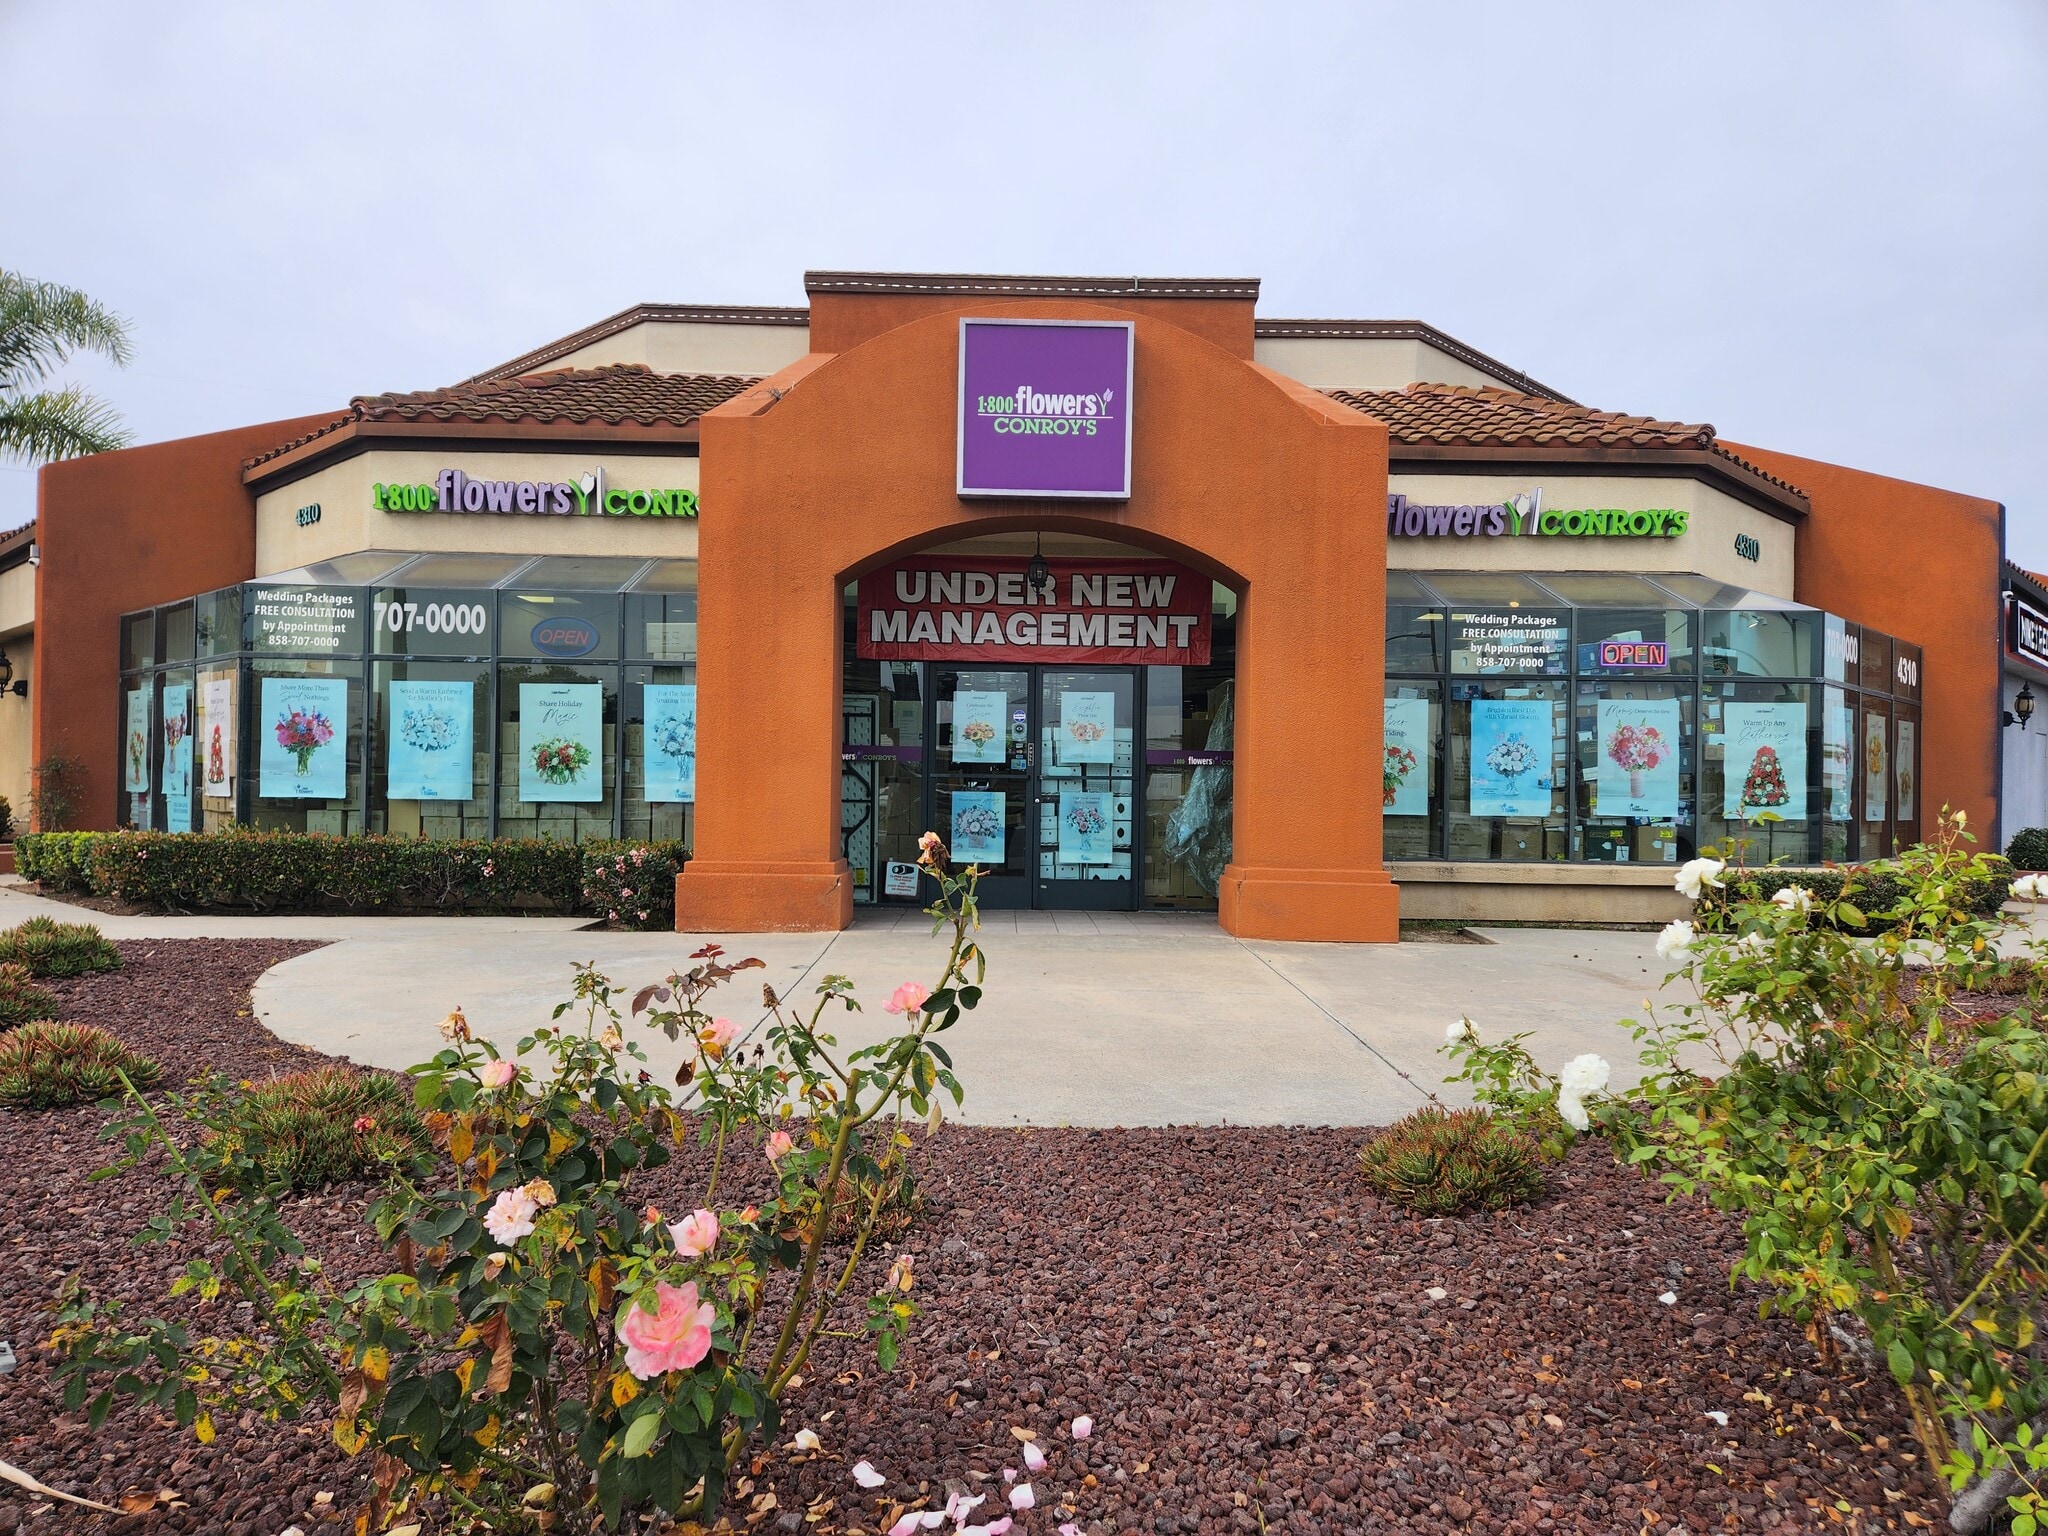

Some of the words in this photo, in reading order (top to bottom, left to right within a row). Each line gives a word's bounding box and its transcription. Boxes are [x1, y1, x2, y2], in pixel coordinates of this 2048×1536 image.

[994, 417, 1097, 436] CONROY'S
[603, 488, 699, 517] CONR
[295, 502, 321, 527] 4310
[1540, 508, 1690, 538] CONROY'S
[1735, 533, 1760, 563] 4310
[257, 590, 303, 604] Wedding
[305, 592, 353, 606] Packages
[895, 570, 1058, 606] UNDER
[1071, 574, 1178, 608] NEW
[254, 605, 279, 616] FREE
[281, 606, 355, 619] CONSULTATION
[373, 601, 486, 635] 707-0000
[1465, 614, 1509, 627] Wedding
[1511, 615, 1557, 628] Packages
[262, 620, 276, 633] by
[277, 620, 346, 633] Appointment
[869, 608, 1199, 649] MANAGEMENT
[1462, 628, 1486, 638] FREE
[1488, 629, 1559, 639] CONSULTATION
[268, 635, 339, 647] 858-707-0000
[539, 628, 590, 647] OPEN
[1470, 643, 1482, 654] by
[1484, 643, 1550, 655] Appointment
[1604, 644, 1664, 664] OPEN
[1476, 658, 1544, 668] 858-707-0000
[1897, 656, 1917, 687] 4310
[1763, 720, 1773, 728] Up
[1188, 756, 1213, 765] flowers
